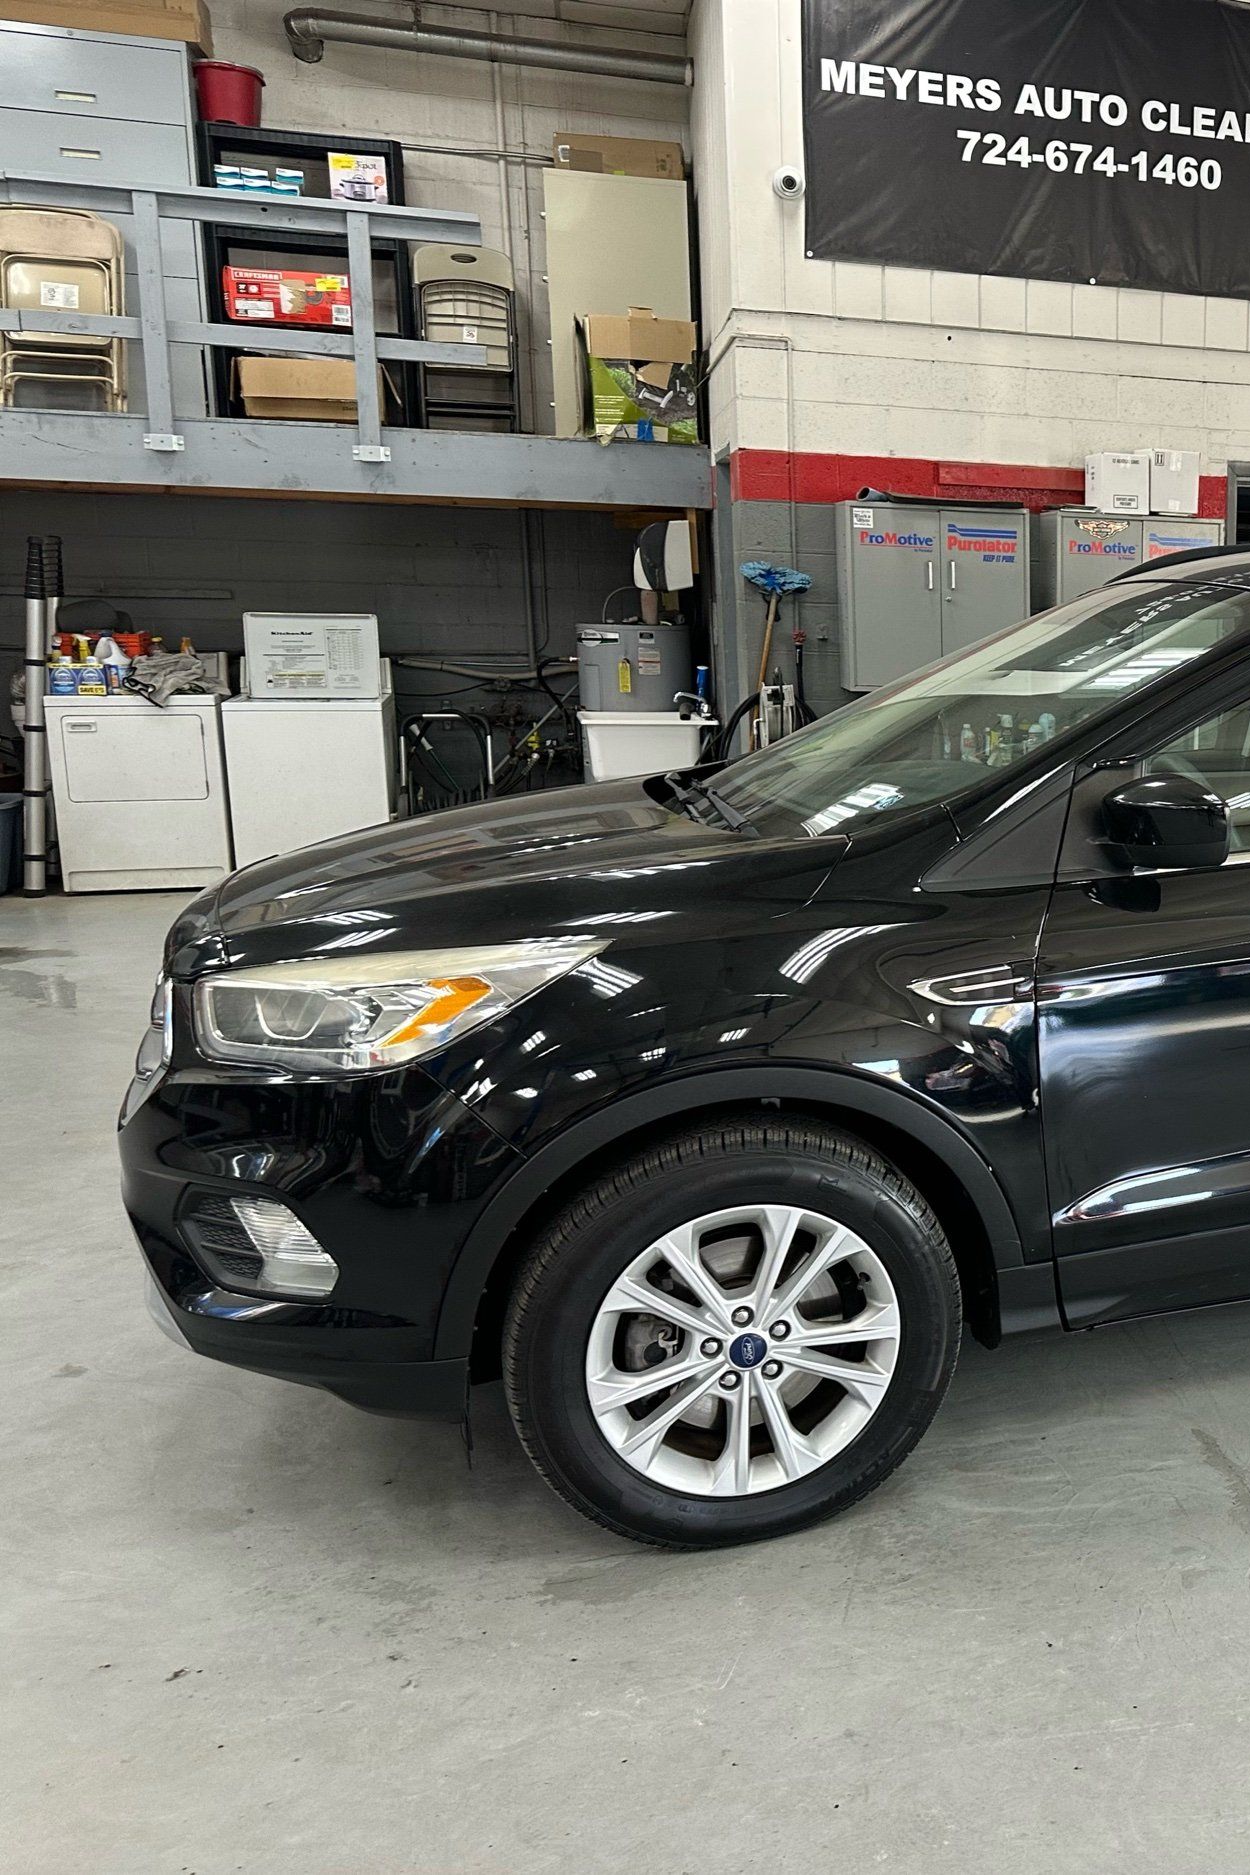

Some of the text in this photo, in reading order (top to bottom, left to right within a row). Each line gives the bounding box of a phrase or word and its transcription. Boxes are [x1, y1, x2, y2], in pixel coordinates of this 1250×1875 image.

[820, 58, 1002, 112] MEYERS
[1014, 84, 1128, 127] AUTO
[956, 129, 1222, 191] 724-674-1460
[233, 270, 280, 280] CRAFTSMAN
[859, 531, 934, 546] ProMotive
[947, 535, 1017, 553] Purolator
[1068, 540, 1137, 554] ProMotive
